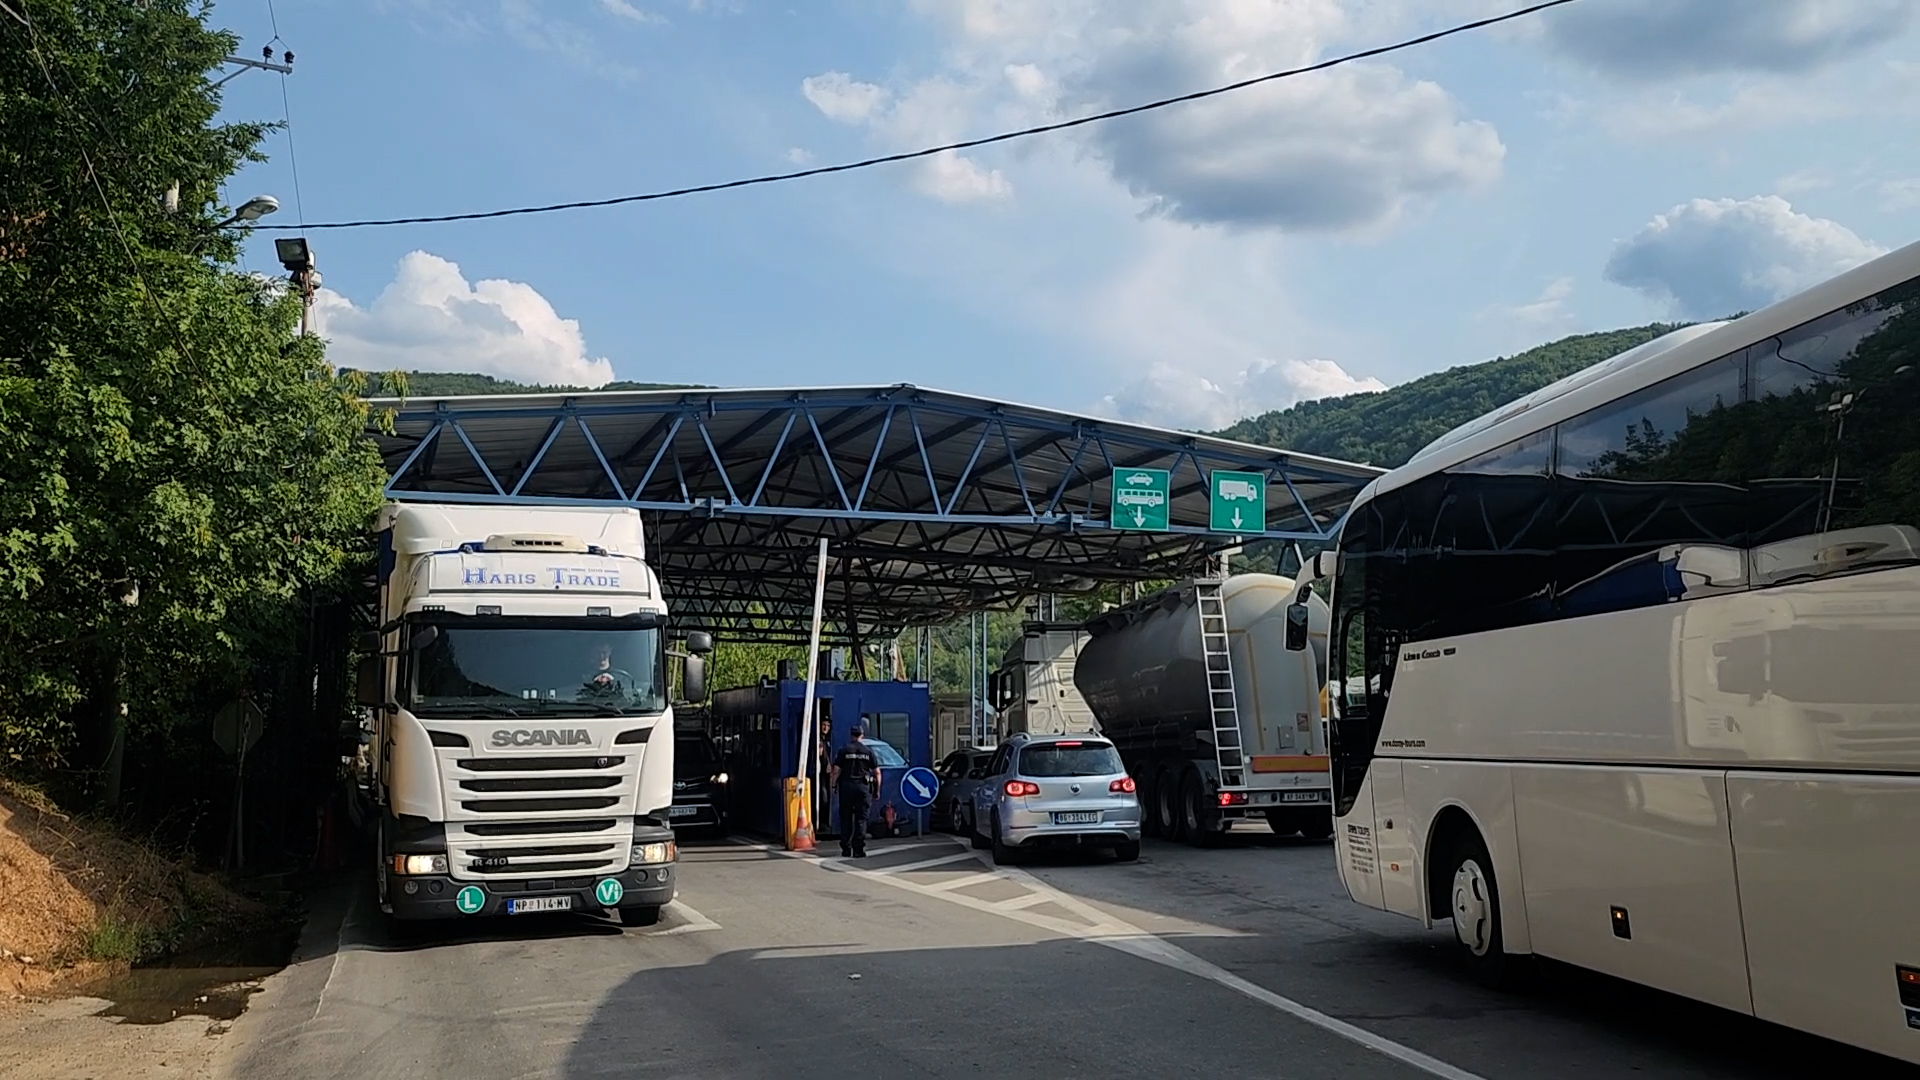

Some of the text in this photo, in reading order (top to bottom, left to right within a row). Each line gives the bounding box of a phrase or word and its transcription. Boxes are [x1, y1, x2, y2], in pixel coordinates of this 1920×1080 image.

[463, 567, 620, 588] HARIS TRADE
[491, 729, 592, 747] SCANIA
[484, 857, 507, 867] 410
[464, 891, 477, 909] L
[515, 900, 528, 911] NP
